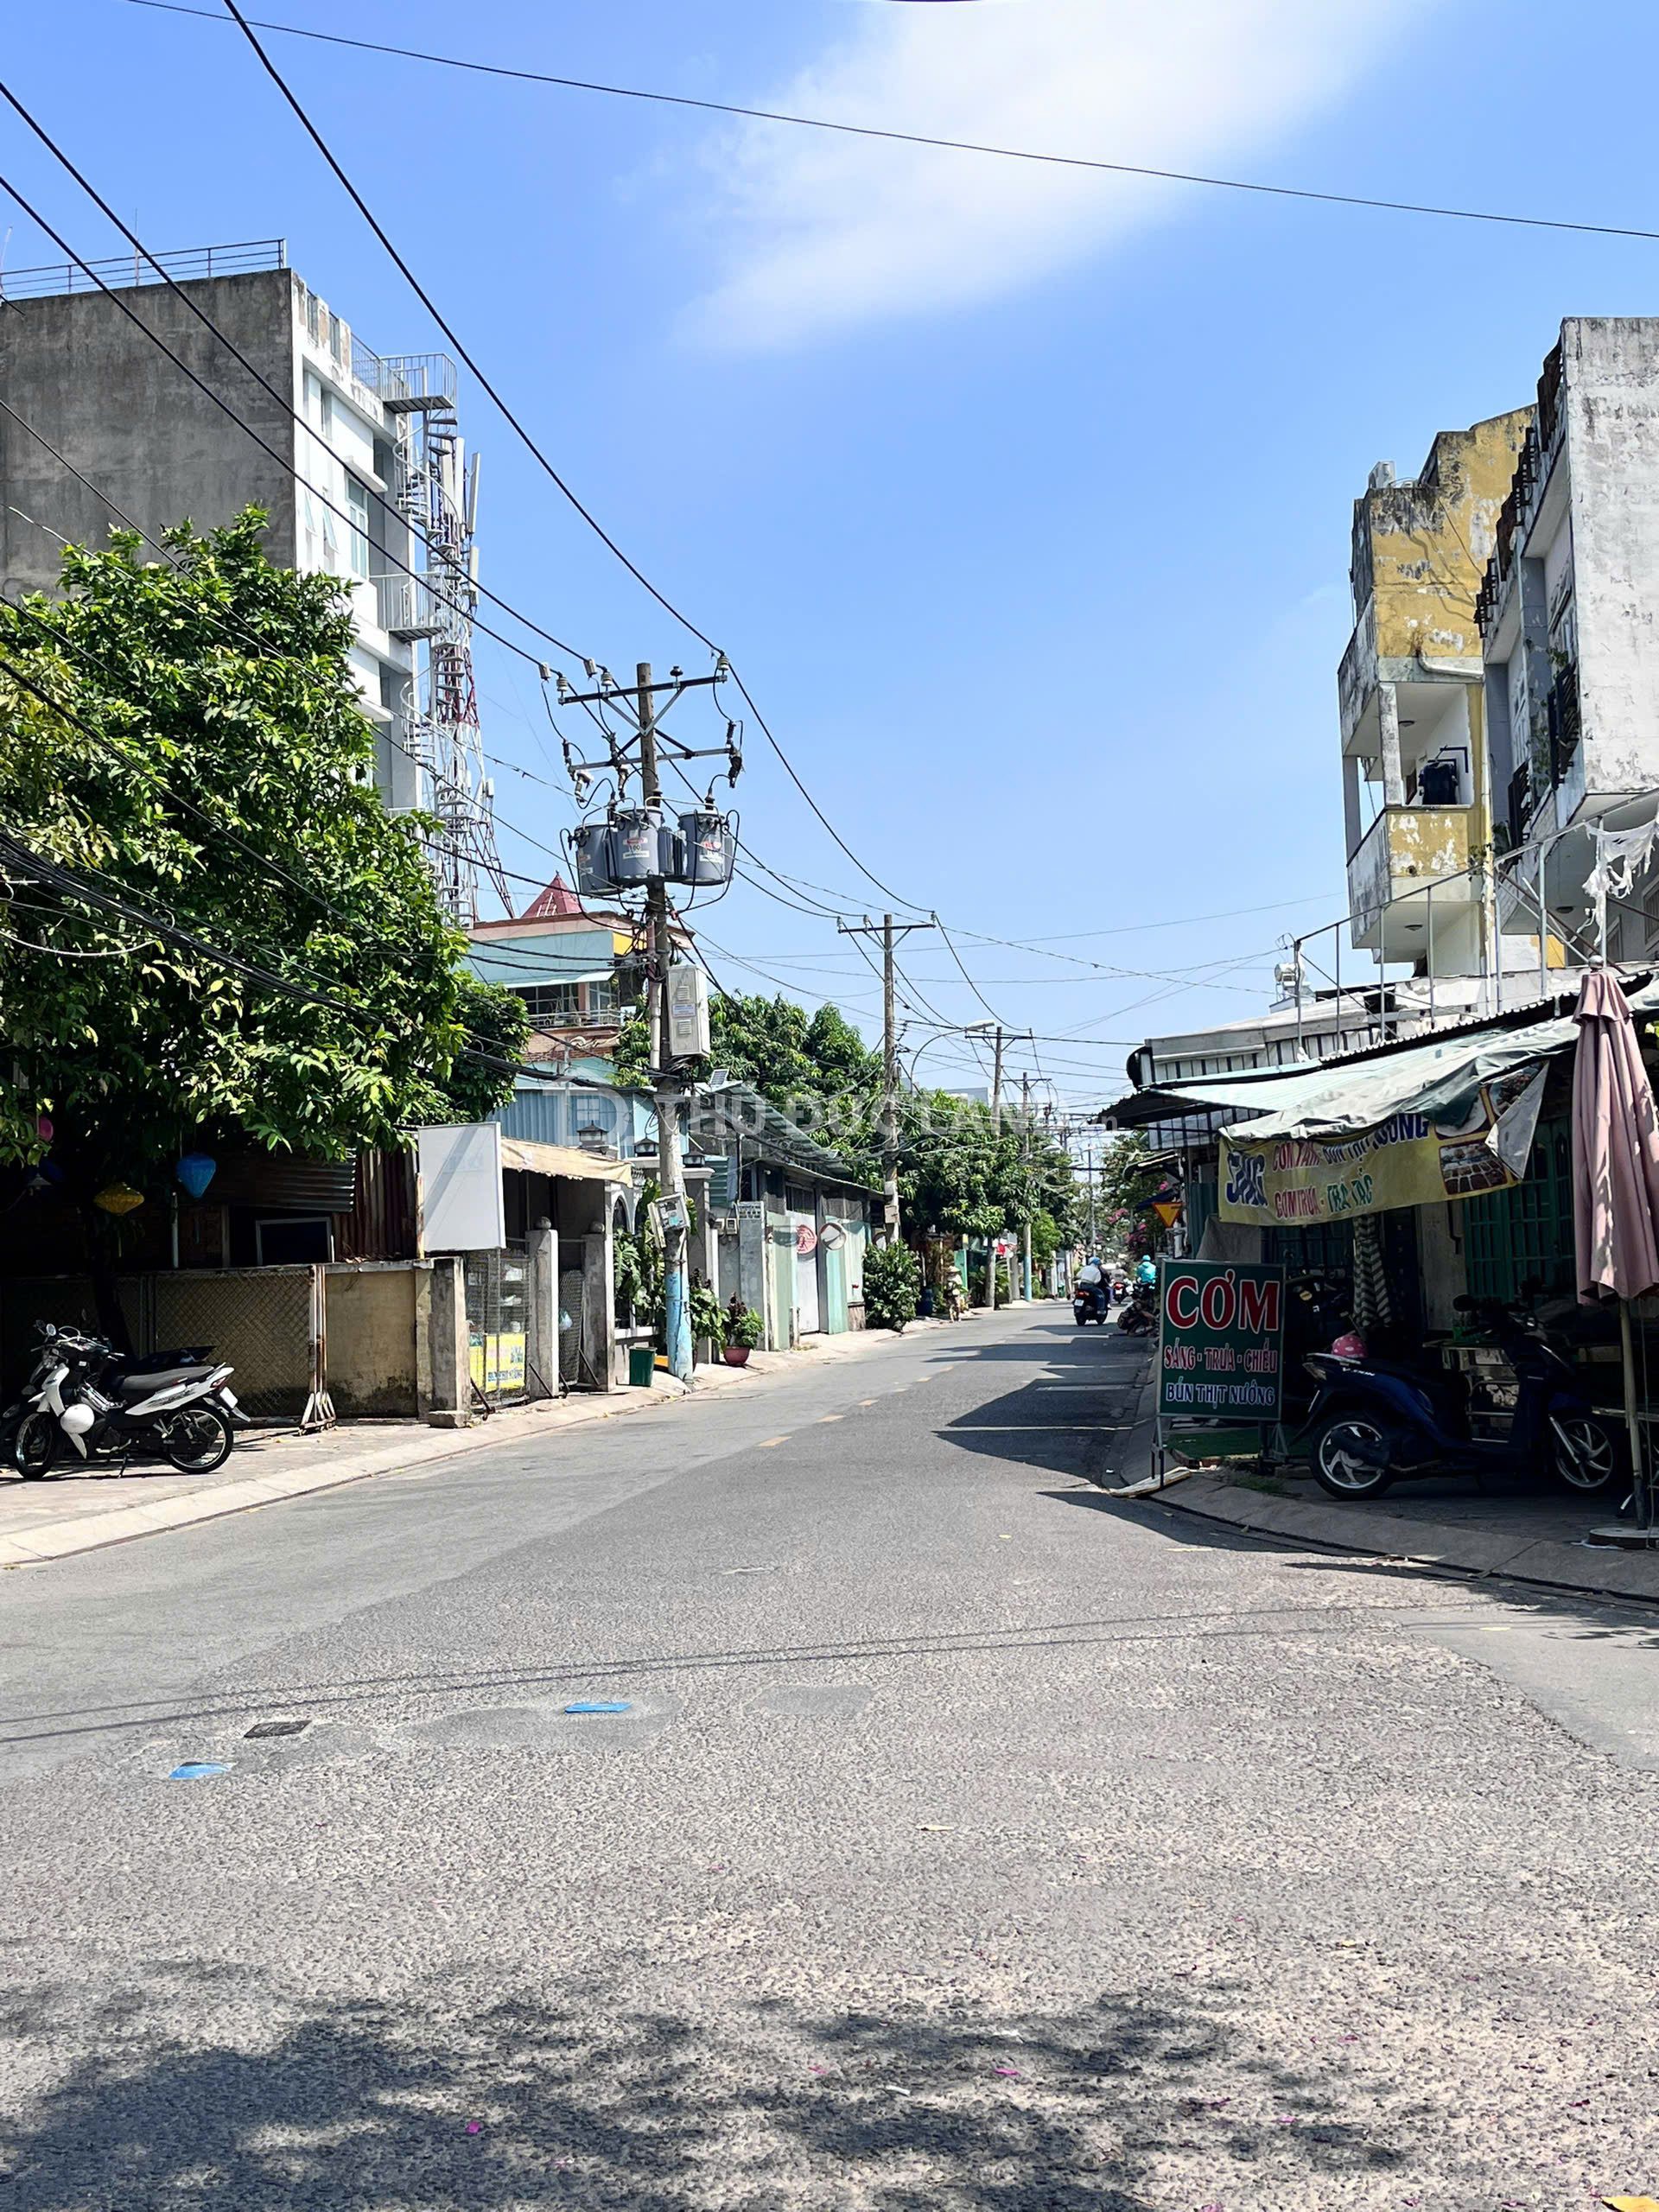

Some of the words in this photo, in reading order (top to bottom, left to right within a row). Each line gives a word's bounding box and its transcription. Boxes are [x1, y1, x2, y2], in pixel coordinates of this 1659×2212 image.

[1166, 1268, 1281, 1334] CƠM
[1164, 1337, 1196, 1370] SÁNG
[1205, 1343, 1236, 1372] TRƯA
[1166, 1376, 1193, 1403] BÚN
[1196, 1384, 1228, 1409] THỊT
[1229, 1379, 1275, 1407] NƯỚNG
